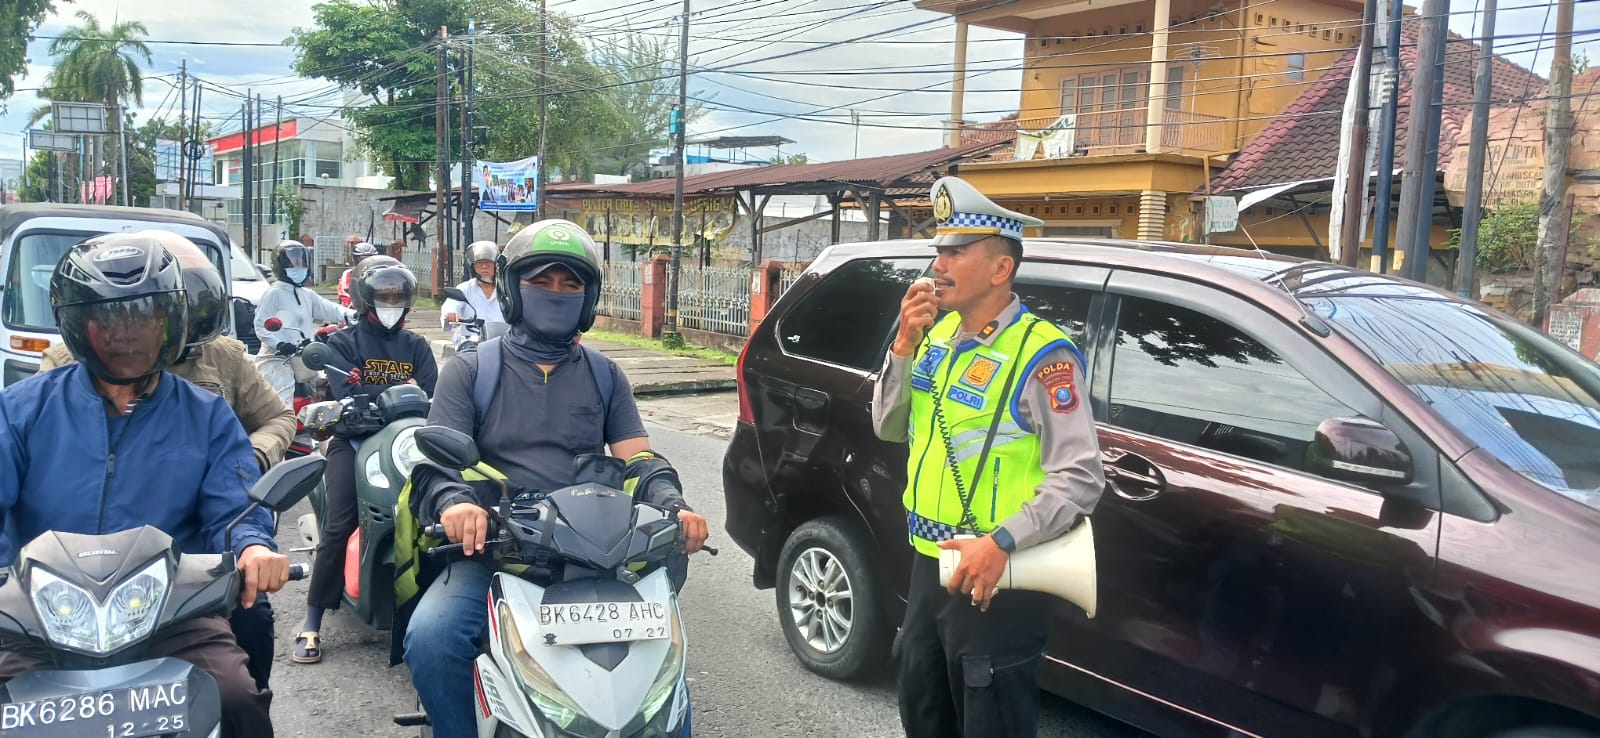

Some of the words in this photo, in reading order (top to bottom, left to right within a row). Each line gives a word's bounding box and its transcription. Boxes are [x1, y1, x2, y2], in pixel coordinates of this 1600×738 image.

[363, 359, 414, 376] STAR
[1037, 362, 1071, 380] POLDA
[948, 388, 981, 408] POLRI
[629, 602, 664, 621] AHC
[613, 628, 633, 639] 07
[646, 627, 665, 638] 27
[130, 683, 186, 712] MAC
